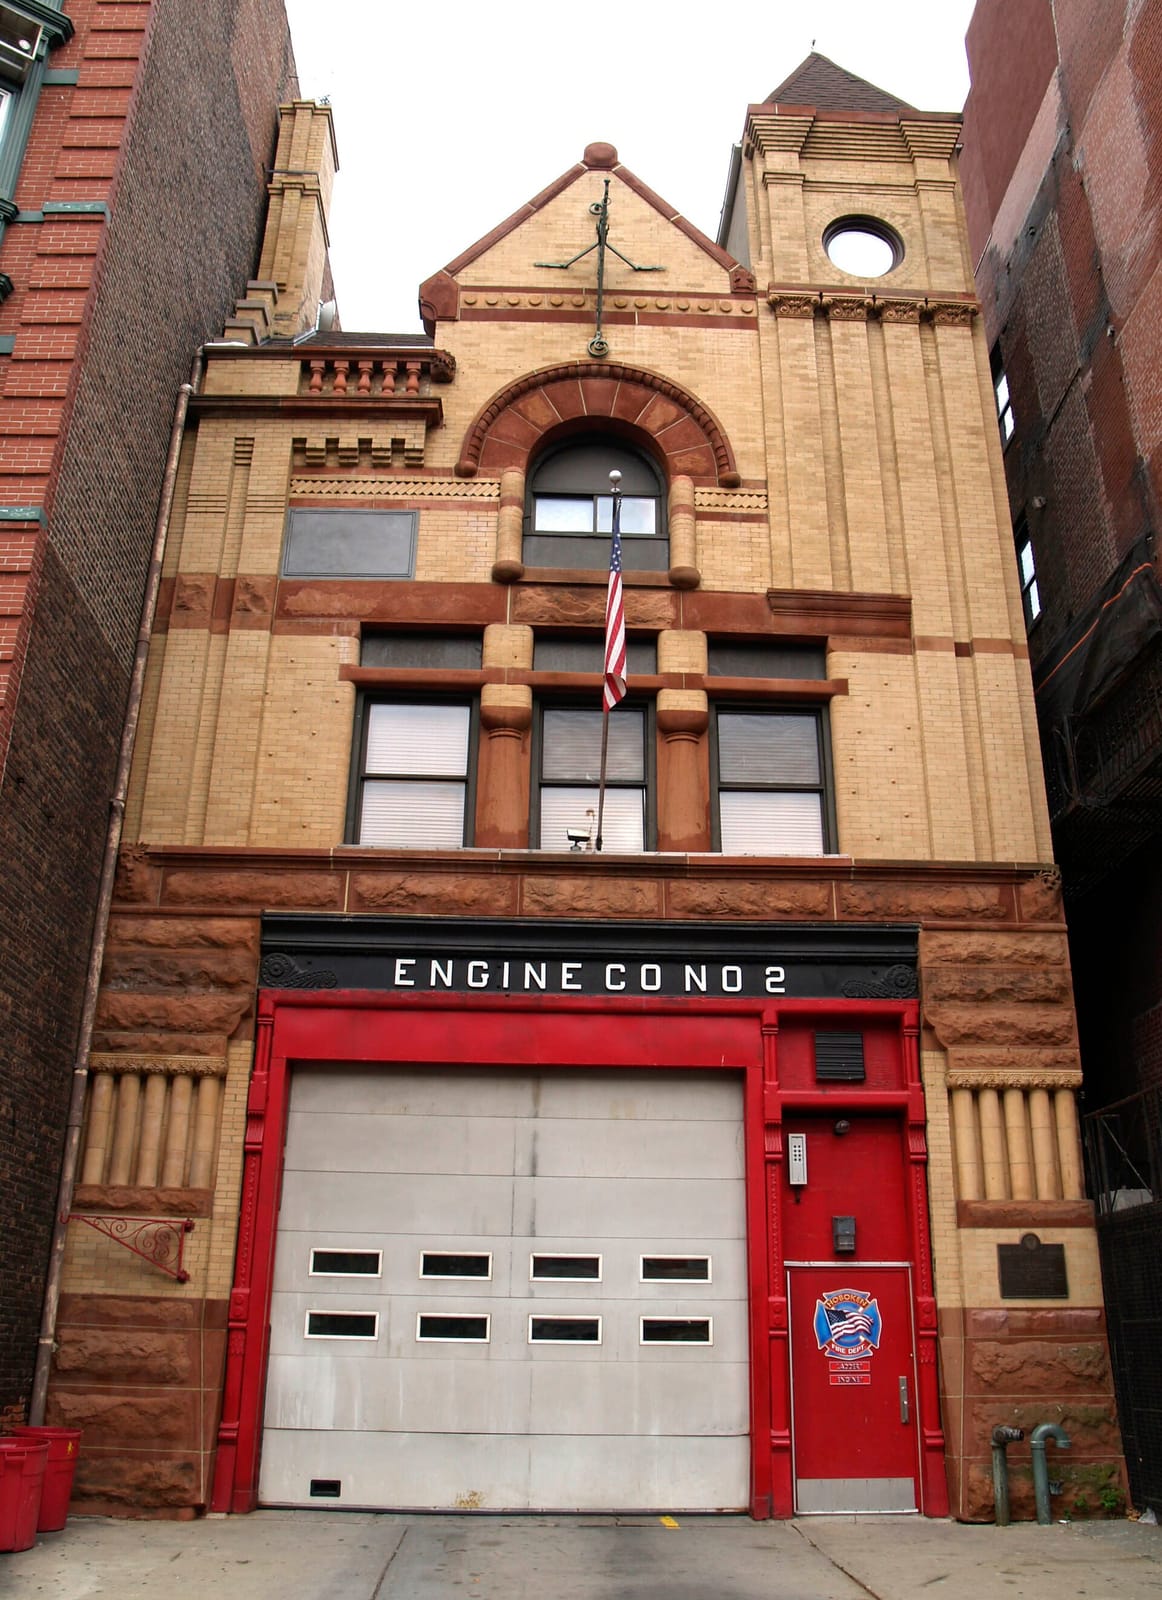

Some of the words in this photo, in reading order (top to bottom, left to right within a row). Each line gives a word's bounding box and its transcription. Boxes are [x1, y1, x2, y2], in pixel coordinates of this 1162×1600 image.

[394, 958, 582, 990] ENGINE
[605, 963, 661, 990] CO
[684, 964, 743, 992] NO
[765, 966, 786, 993] 2
[826, 1293, 868, 1308] HOBOKEN
[831, 1343, 846, 1354] FIRE
